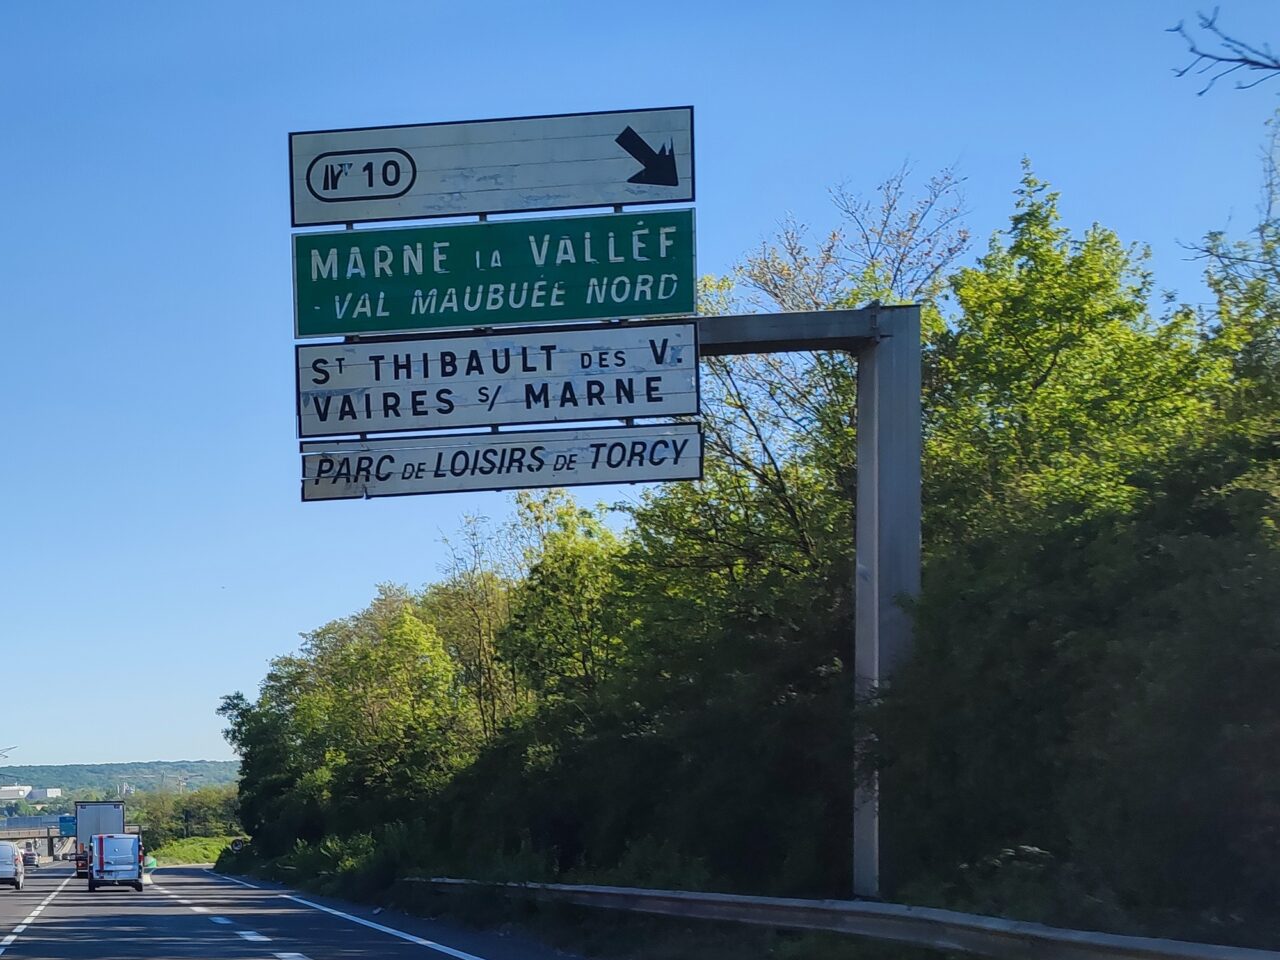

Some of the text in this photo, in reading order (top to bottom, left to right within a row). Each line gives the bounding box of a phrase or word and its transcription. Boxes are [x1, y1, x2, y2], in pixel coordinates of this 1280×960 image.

[362, 159, 401, 188] 10
[311, 241, 450, 282] MARNE
[475, 248, 503, 272] LA
[334, 291, 391, 320] VAL
[586, 272, 679, 305] NORD
[369, 344, 558, 382] THIBAULT
[580, 350, 627, 370] DES
[312, 387, 455, 422] VAIRES
[524, 376, 664, 410] MARNE
[314, 438, 689, 486] PARC DE LOISIRS DE TORCY
